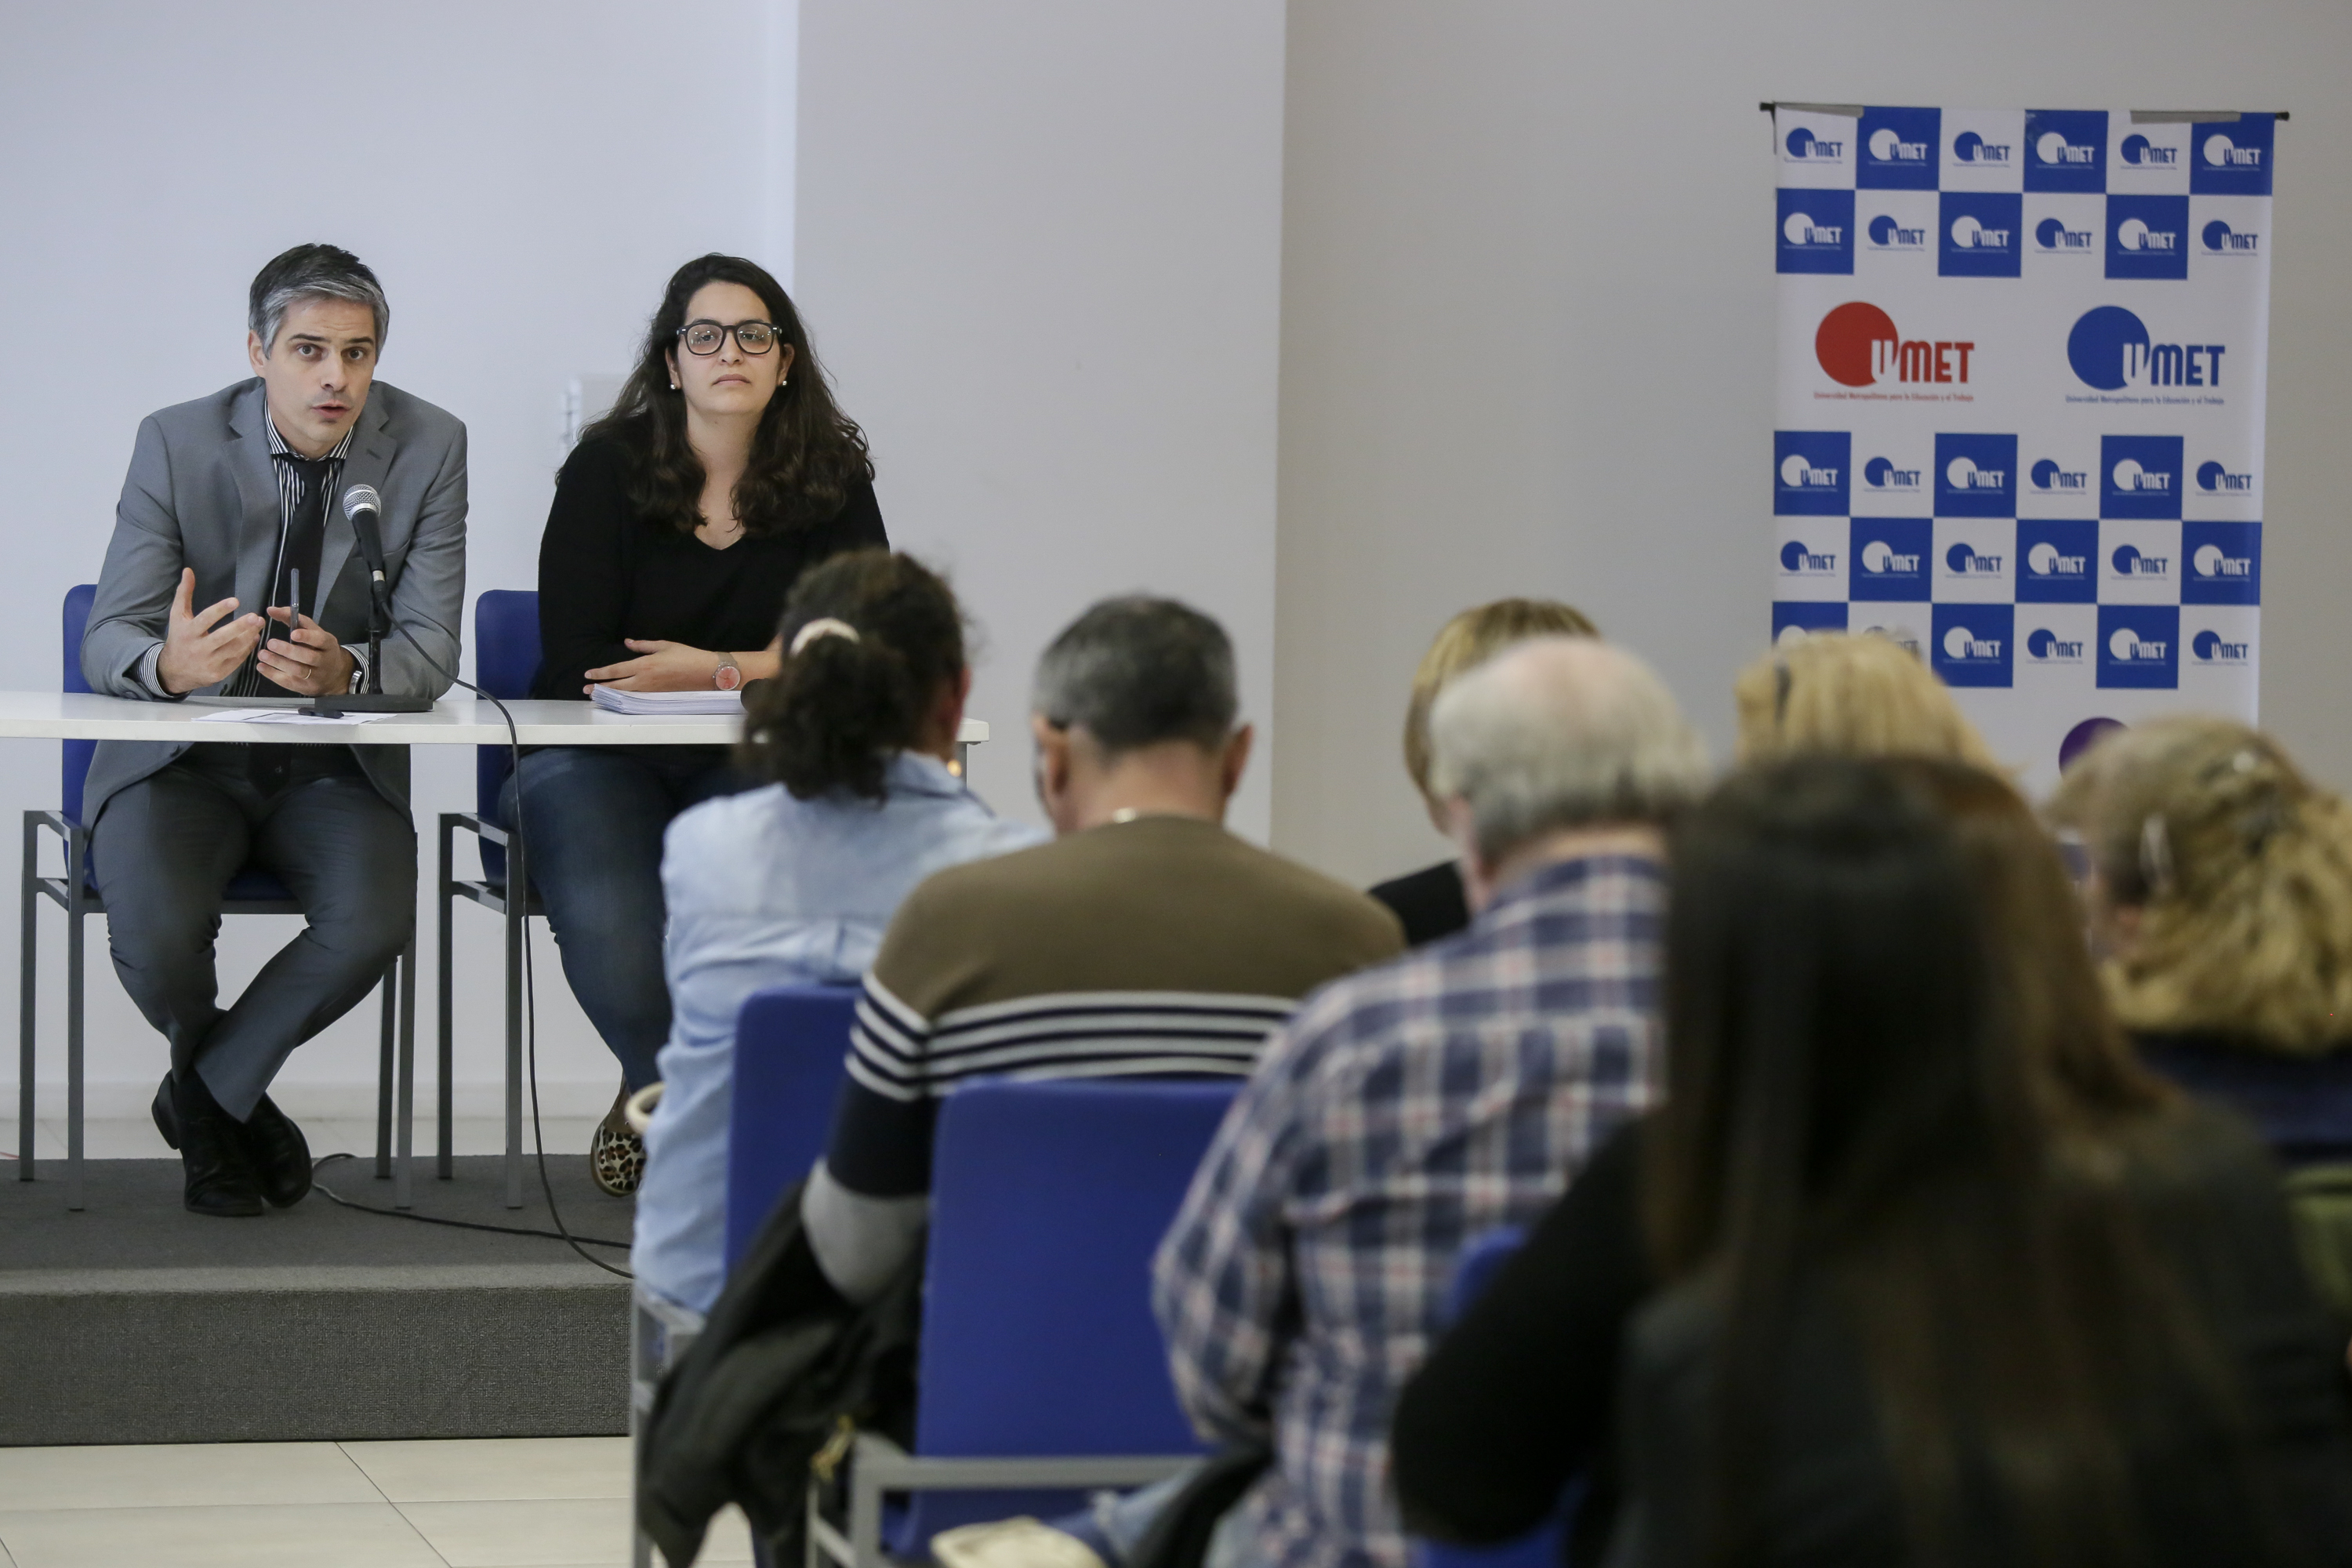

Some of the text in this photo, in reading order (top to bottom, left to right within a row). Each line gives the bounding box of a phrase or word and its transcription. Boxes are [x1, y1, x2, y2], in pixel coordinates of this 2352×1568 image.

[1806, 140, 1842, 158] UMET
[1890, 142, 1927, 160] UMET
[1973, 144, 2010, 162] UMET
[2057, 145, 2095, 162] UMET
[2140, 146, 2176, 163] UMET
[2224, 147, 2261, 165] UMET
[1805, 227, 1842, 244] UMET
[1888, 227, 1925, 245] UMET
[1972, 230, 2009, 247] UMET
[2055, 230, 2092, 248] UMET
[2139, 232, 2176, 249] UMET
[2222, 233, 2258, 250] UMET
[1871, 339, 1974, 383] UMET
[2122, 343, 2226, 387] UMET
[1800, 469, 1838, 485] UMET
[1883, 470, 1921, 487] UMET
[1967, 470, 2004, 488] UMET
[2050, 472, 2087, 488] UMET
[2133, 472, 2170, 490] UMET
[2216, 473, 2252, 490] UMET
[1798, 554, 1836, 571] UMET
[1882, 554, 1920, 572] UMET
[1965, 555, 2002, 572] UMET
[2049, 555, 2085, 574] UMET
[2132, 557, 2168, 574] UMET
[2215, 557, 2251, 575] UMET
[1965, 639, 2002, 658] UMET
[2046, 641, 2082, 658] UMET
[2130, 641, 2166, 659] UMET
[2212, 642, 2248, 659] UMET
